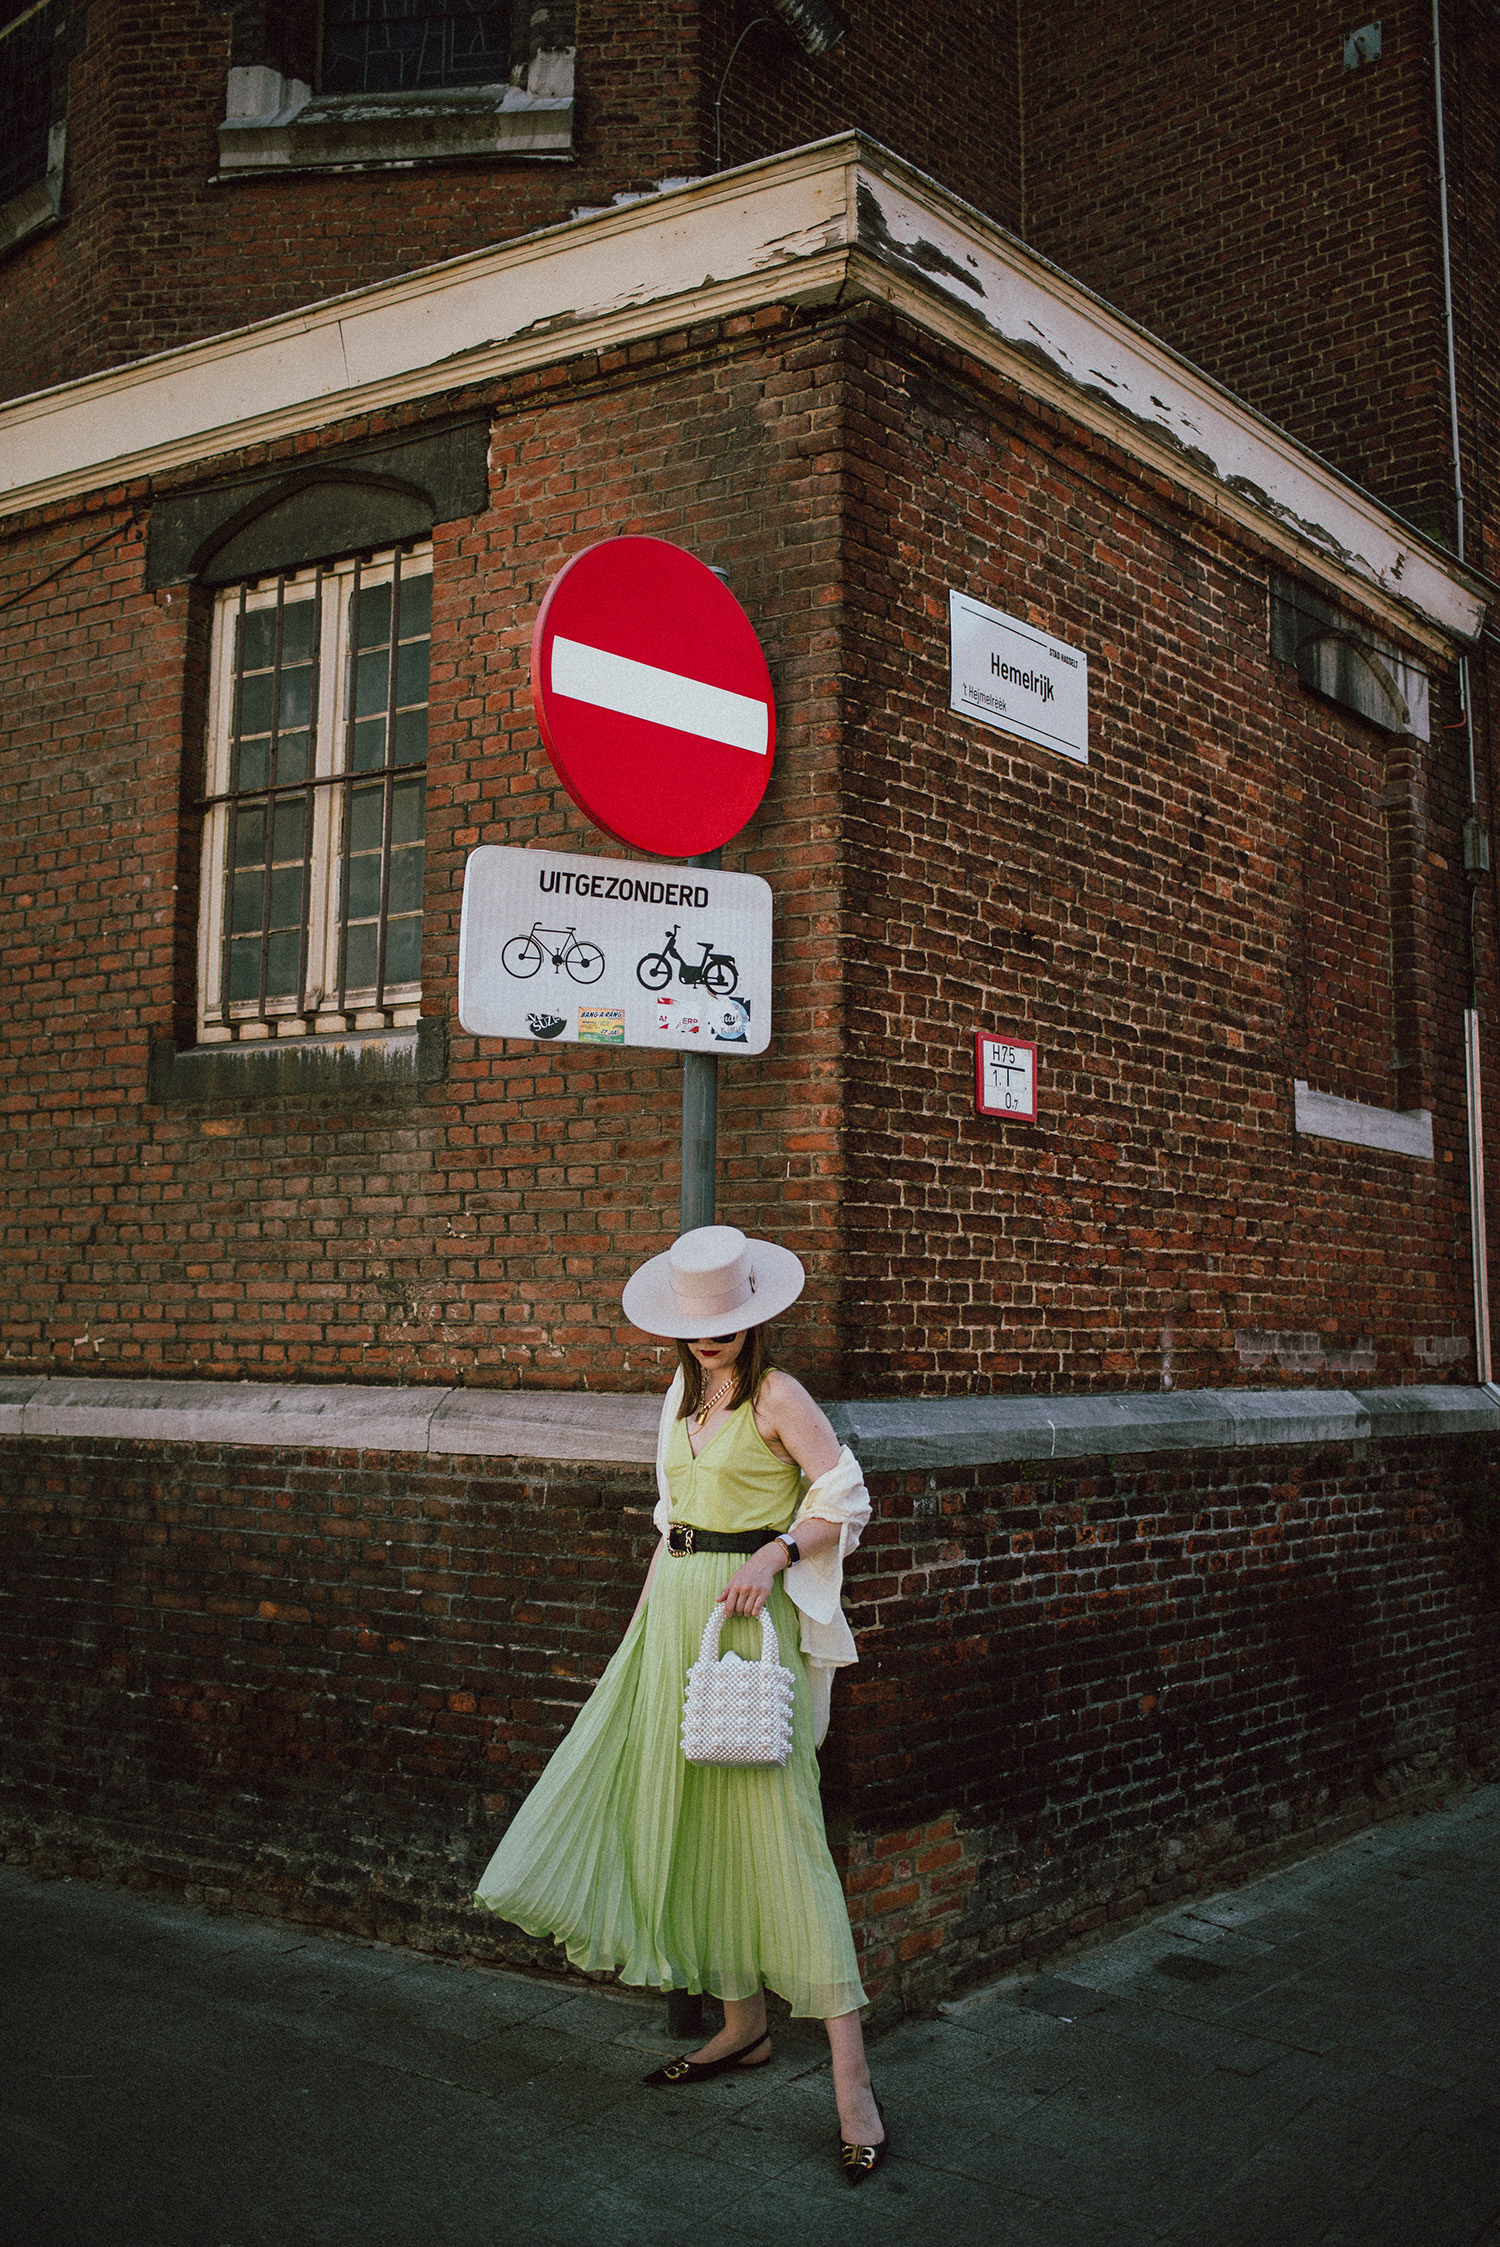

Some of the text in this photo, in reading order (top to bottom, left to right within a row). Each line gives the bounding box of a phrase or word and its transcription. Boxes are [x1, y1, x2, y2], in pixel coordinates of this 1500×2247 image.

[1049, 648, 1078, 668] STAD HASSELT
[991, 652, 1055, 702] Hemelrijk
[539, 869, 709, 909] UITGEZONDERD
[992, 1044, 1016, 1064] H75
[1005, 1092, 1019, 1110] 0.7
